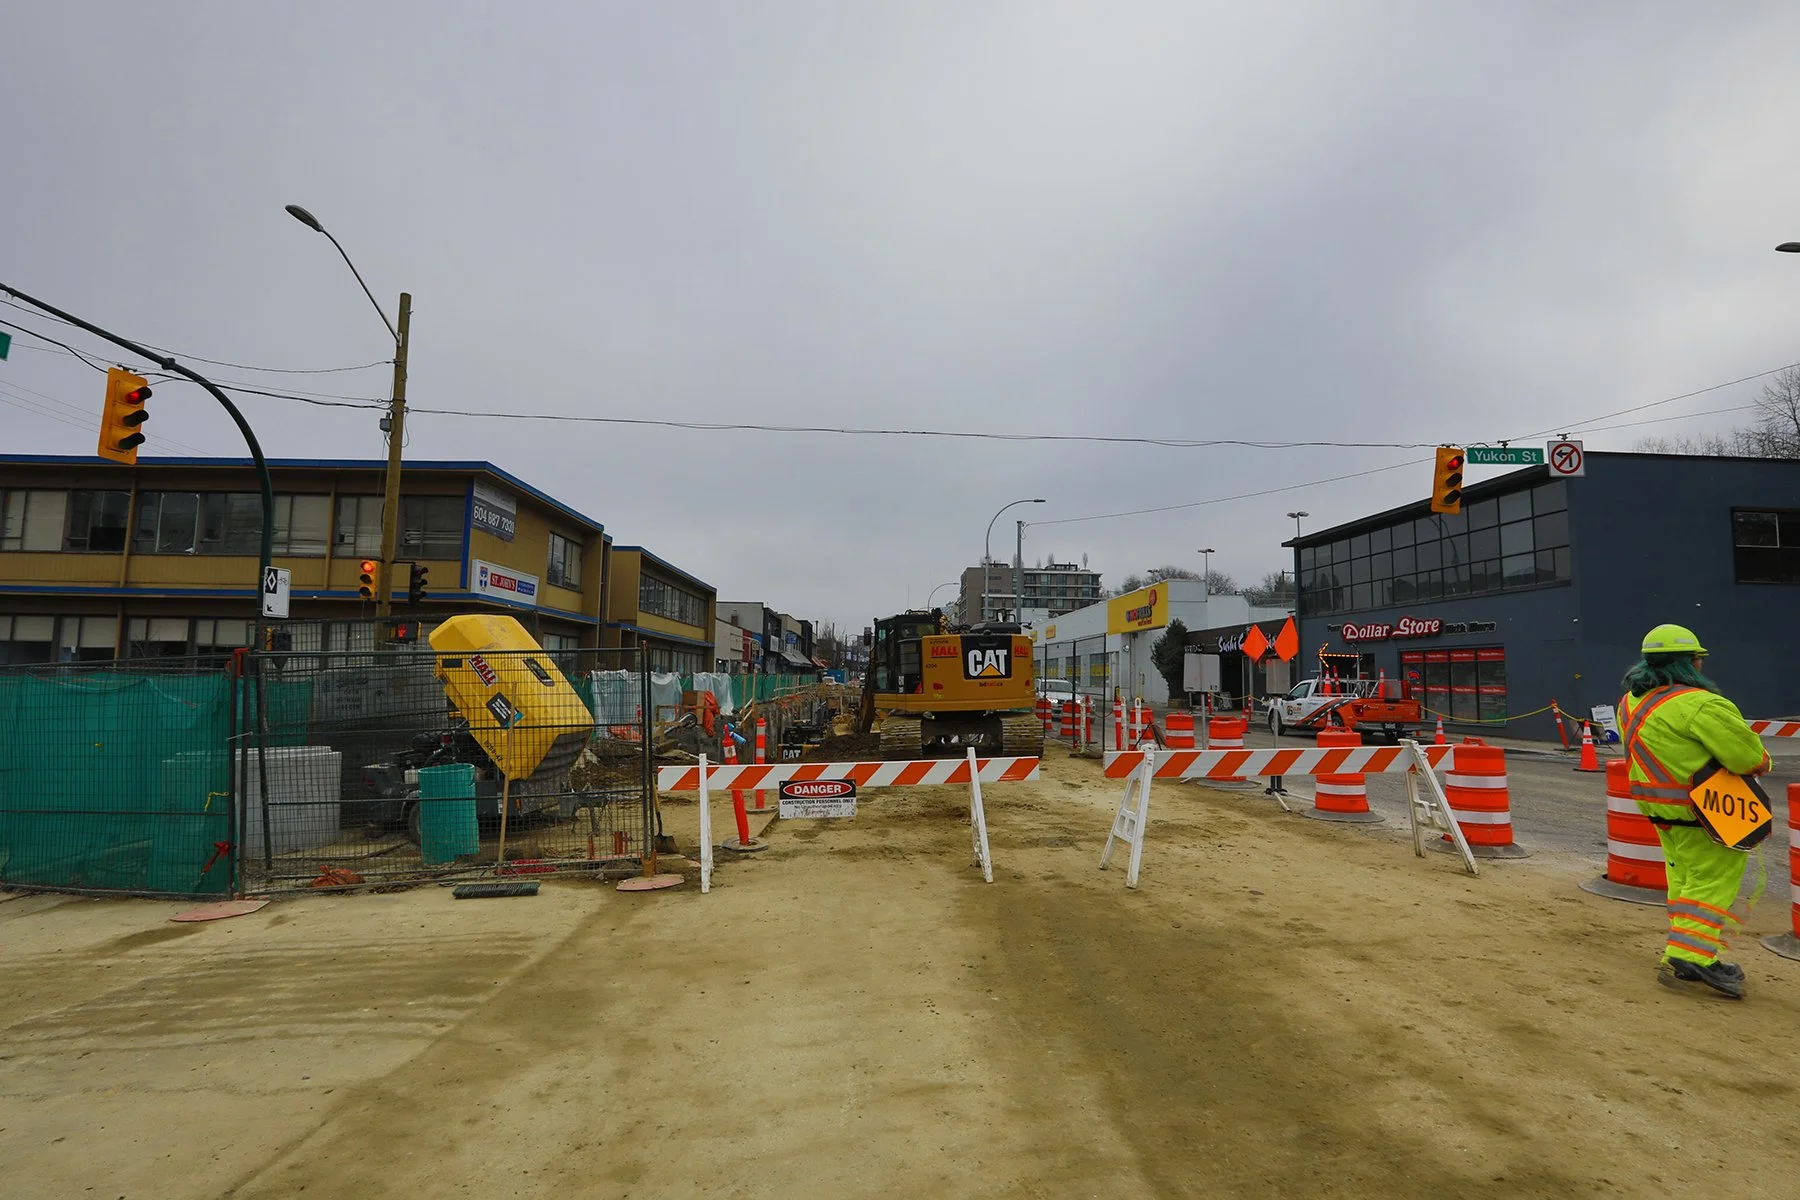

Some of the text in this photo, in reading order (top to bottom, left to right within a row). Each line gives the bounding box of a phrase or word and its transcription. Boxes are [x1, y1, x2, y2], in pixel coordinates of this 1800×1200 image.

[1474, 450, 1537, 463] Yukon St
[473, 505, 487, 522] 604
[488, 511, 500, 527] 687
[1342, 623, 1390, 639] Dollar
[1392, 618, 1440, 636] Store
[931, 646, 958, 656] HALL
[1218, 634, 1237, 653] Sushi
[471, 654, 498, 685] HALL
[968, 649, 1007, 677] CAT
[782, 745, 801, 759] CAT
[794, 784, 842, 795] DANGER
[1703, 788, 1759, 823] SLOW
